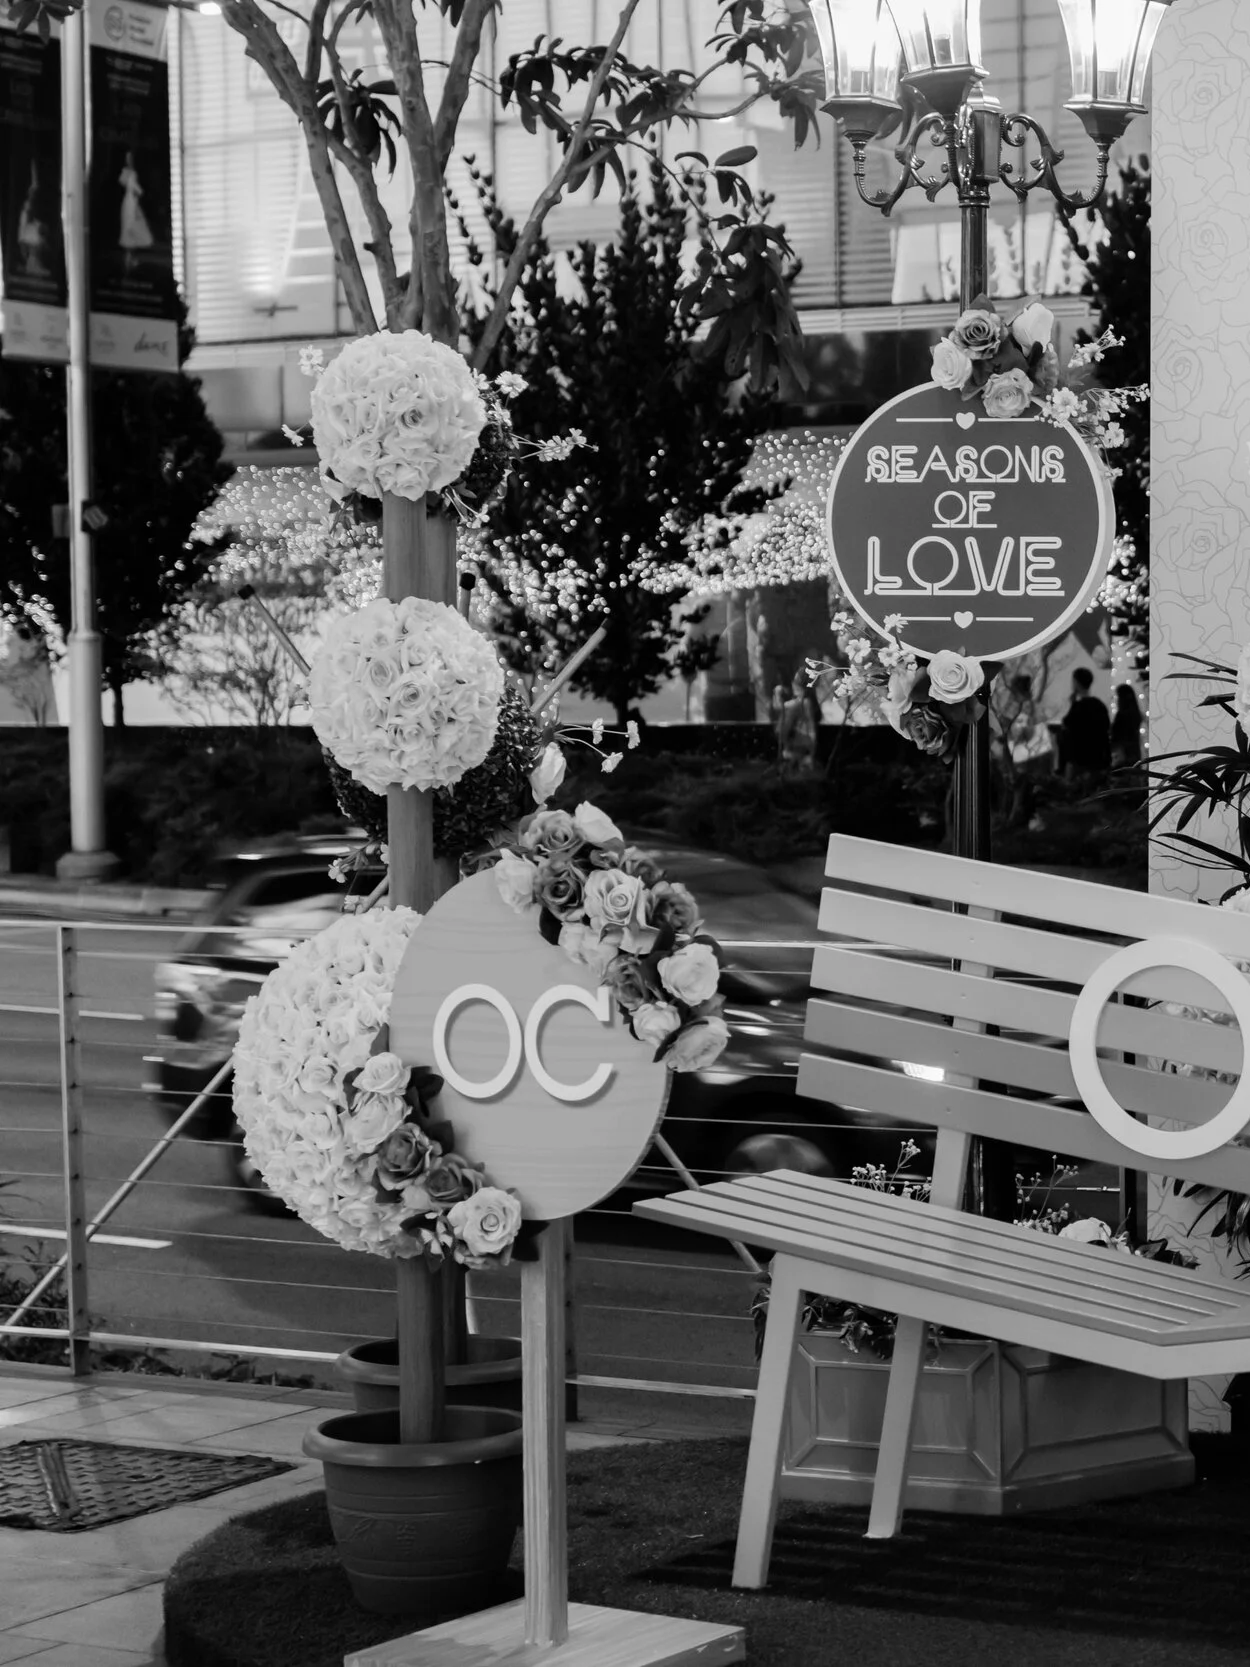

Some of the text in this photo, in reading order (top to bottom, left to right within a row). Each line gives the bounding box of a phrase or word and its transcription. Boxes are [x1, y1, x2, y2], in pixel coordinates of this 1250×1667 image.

[865, 445, 1066, 483] SEASONS
[932, 490, 998, 528] OF
[864, 536, 1065, 596] LOVE
[433, 983, 614, 1101] OC
